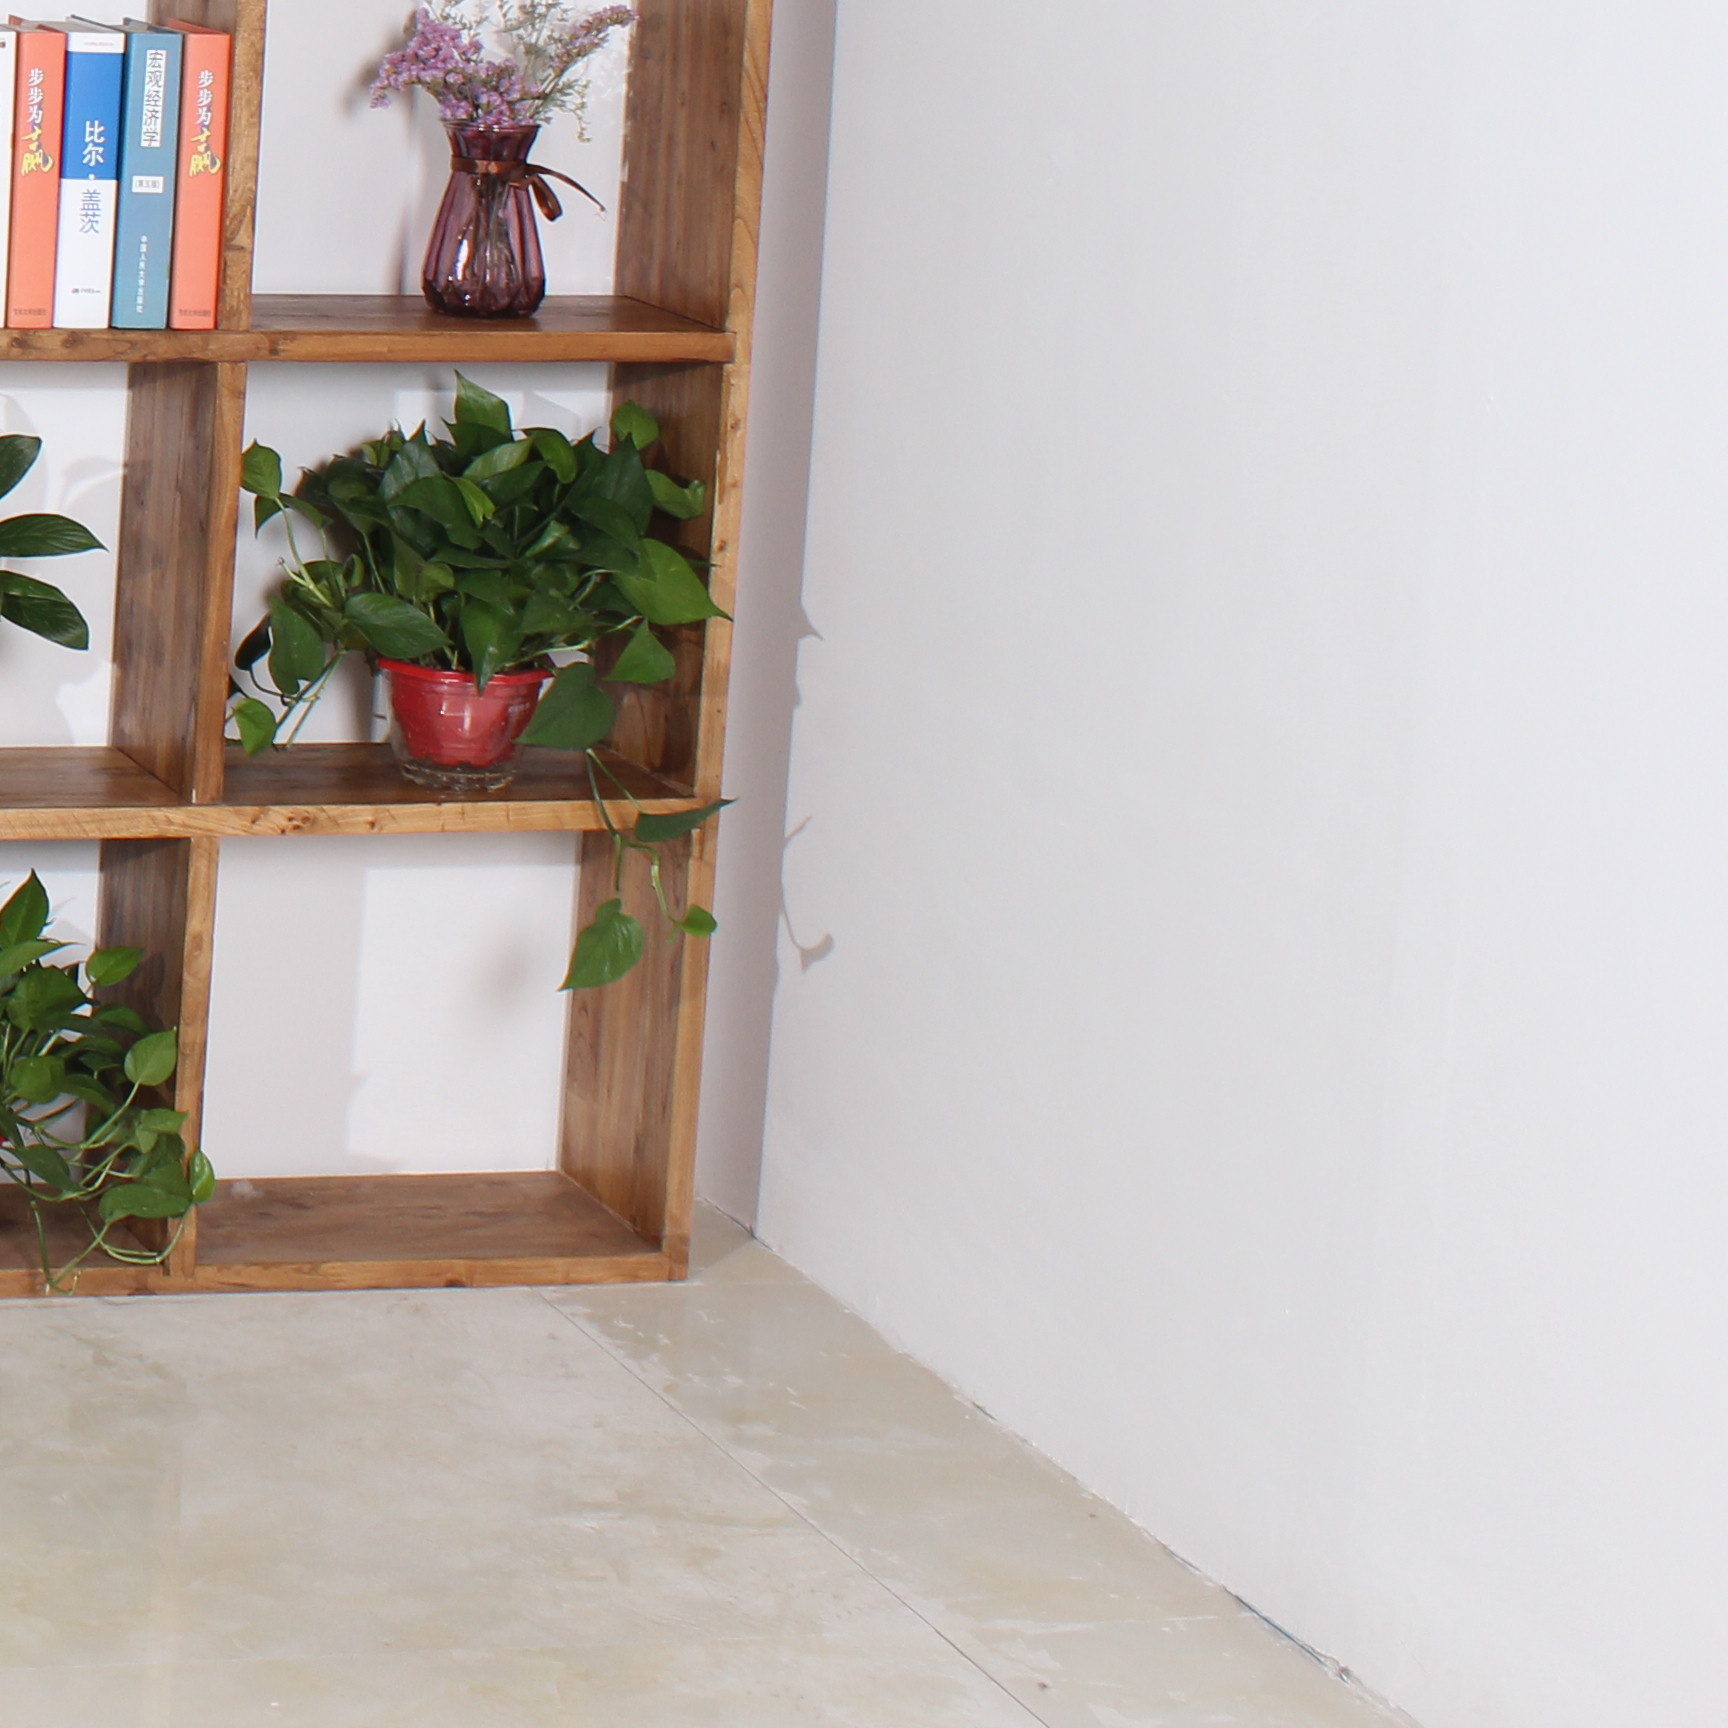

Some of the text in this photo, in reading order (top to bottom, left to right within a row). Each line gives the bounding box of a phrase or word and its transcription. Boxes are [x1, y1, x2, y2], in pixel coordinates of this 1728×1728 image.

[142, 51, 165, 147] 宏观经济学
